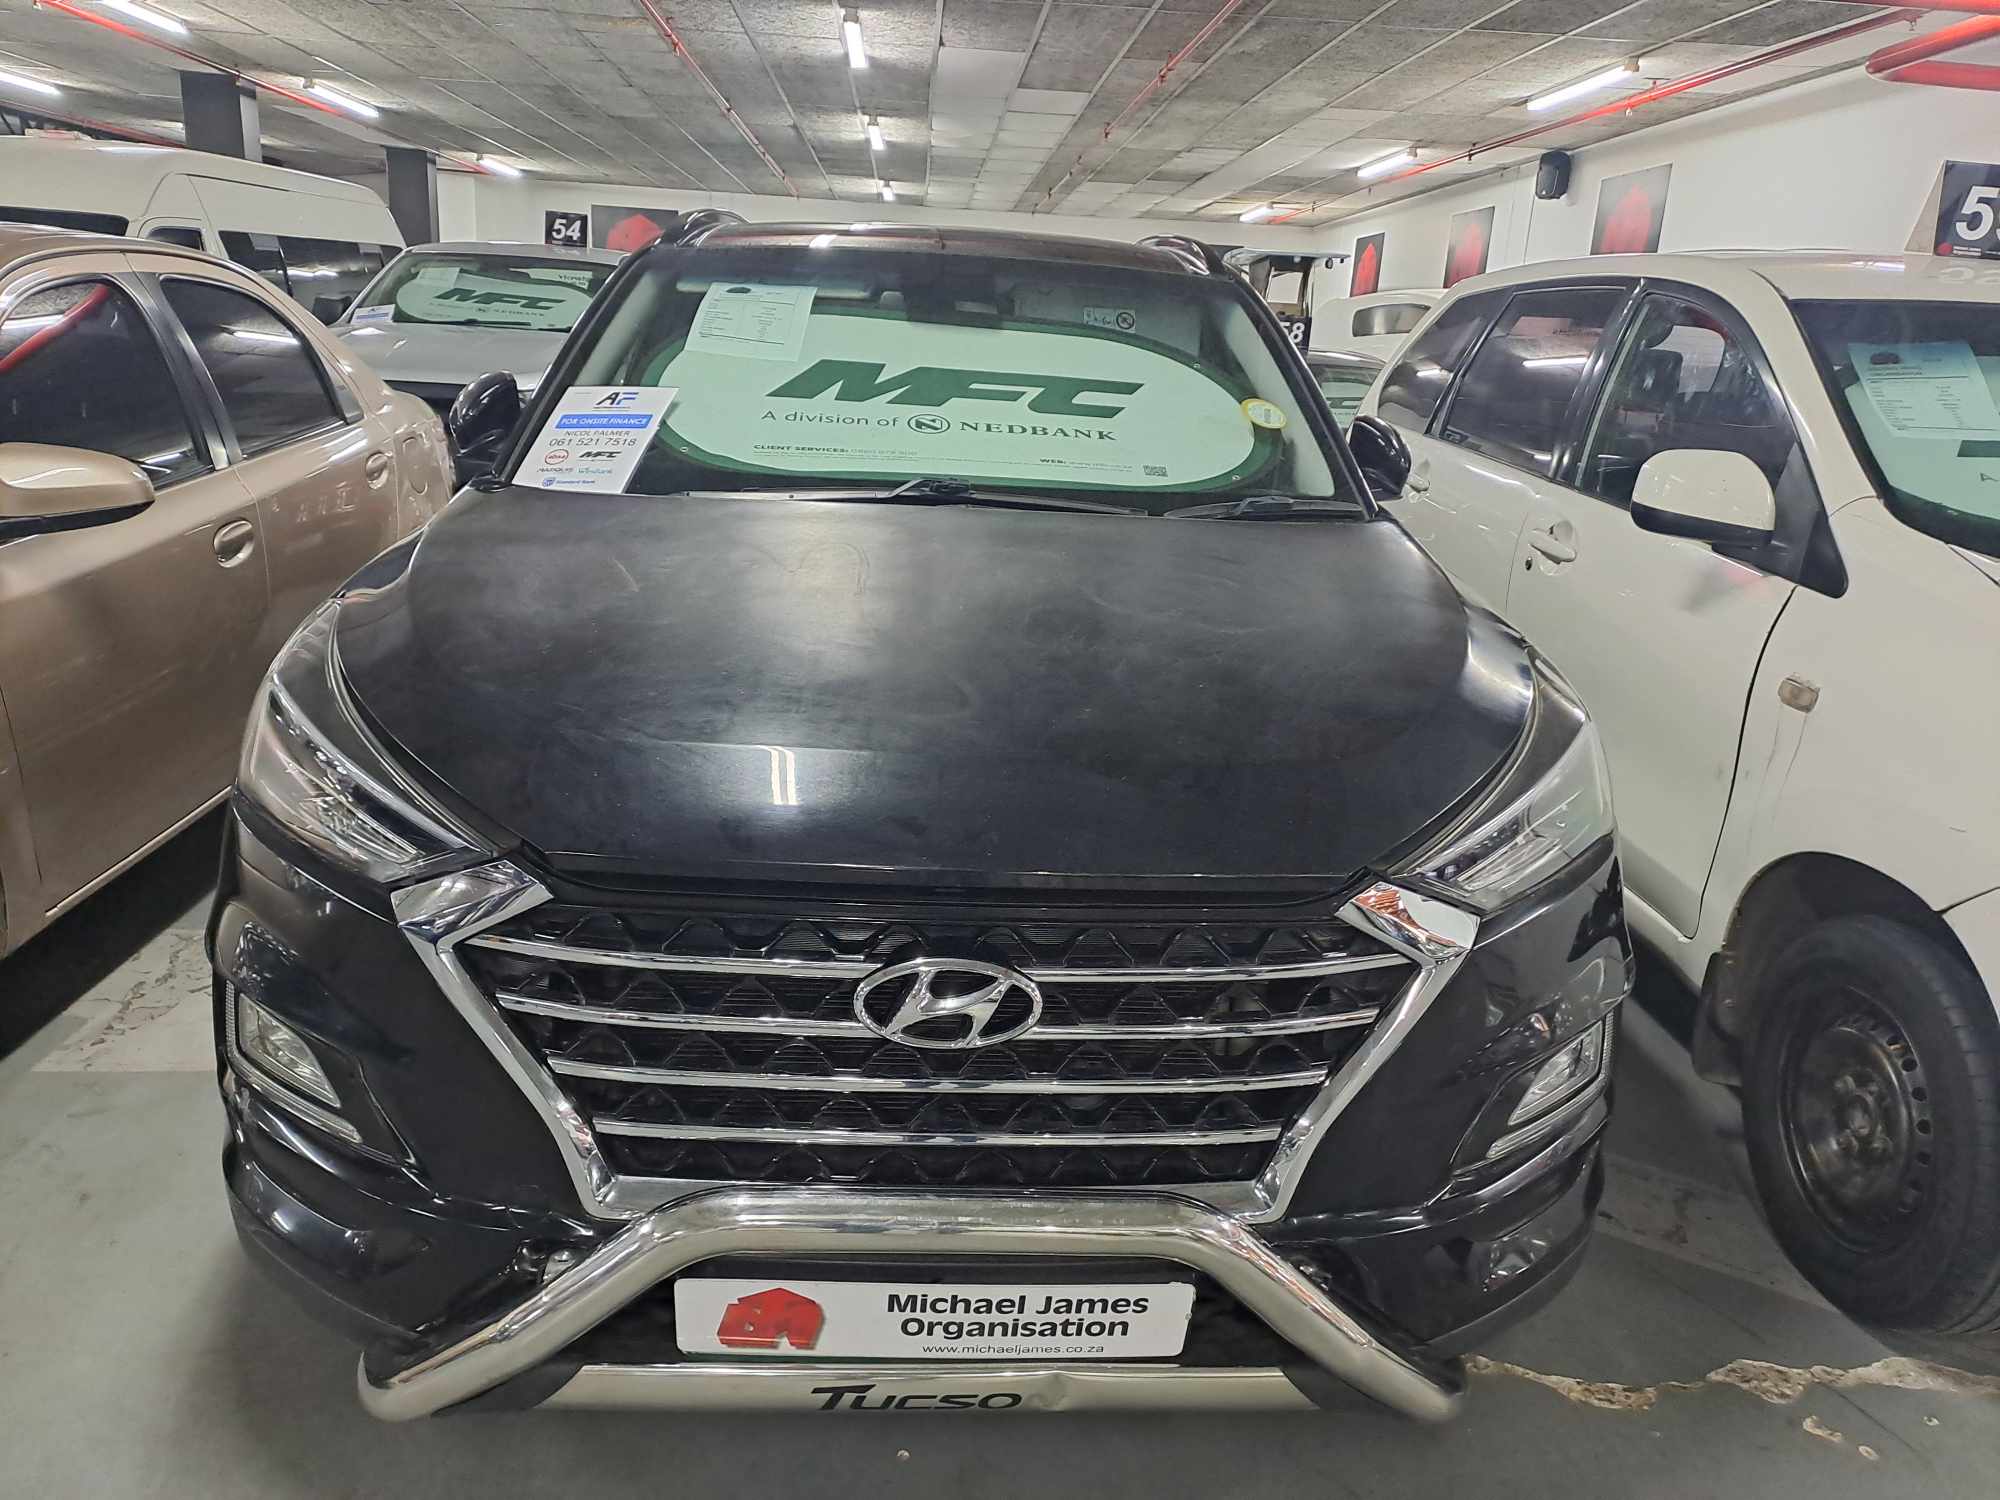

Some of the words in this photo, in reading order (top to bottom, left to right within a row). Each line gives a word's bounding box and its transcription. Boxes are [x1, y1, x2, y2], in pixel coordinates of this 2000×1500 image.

[552, 218, 582, 241] 54
[433, 287, 567, 310] MFC
[766, 359, 1145, 418] MFC
[561, 417, 578, 425] FOR
[609, 417, 648, 425] FINANCE
[761, 410, 776, 420] A
[784, 411, 869, 425] division
[877, 416, 899, 427] of
[960, 421, 1116, 441] NEDBANK
[549, 438, 572, 447] 061
[576, 438, 600, 447] 521
[604, 438, 637, 447] 7518
[887, 1294, 1026, 1315] Michael
[1036, 1295, 1149, 1315] James
[900, 1317, 1130, 1340] Organisation
[922, 1344, 1105, 1355] www.michaeljames.co.za
